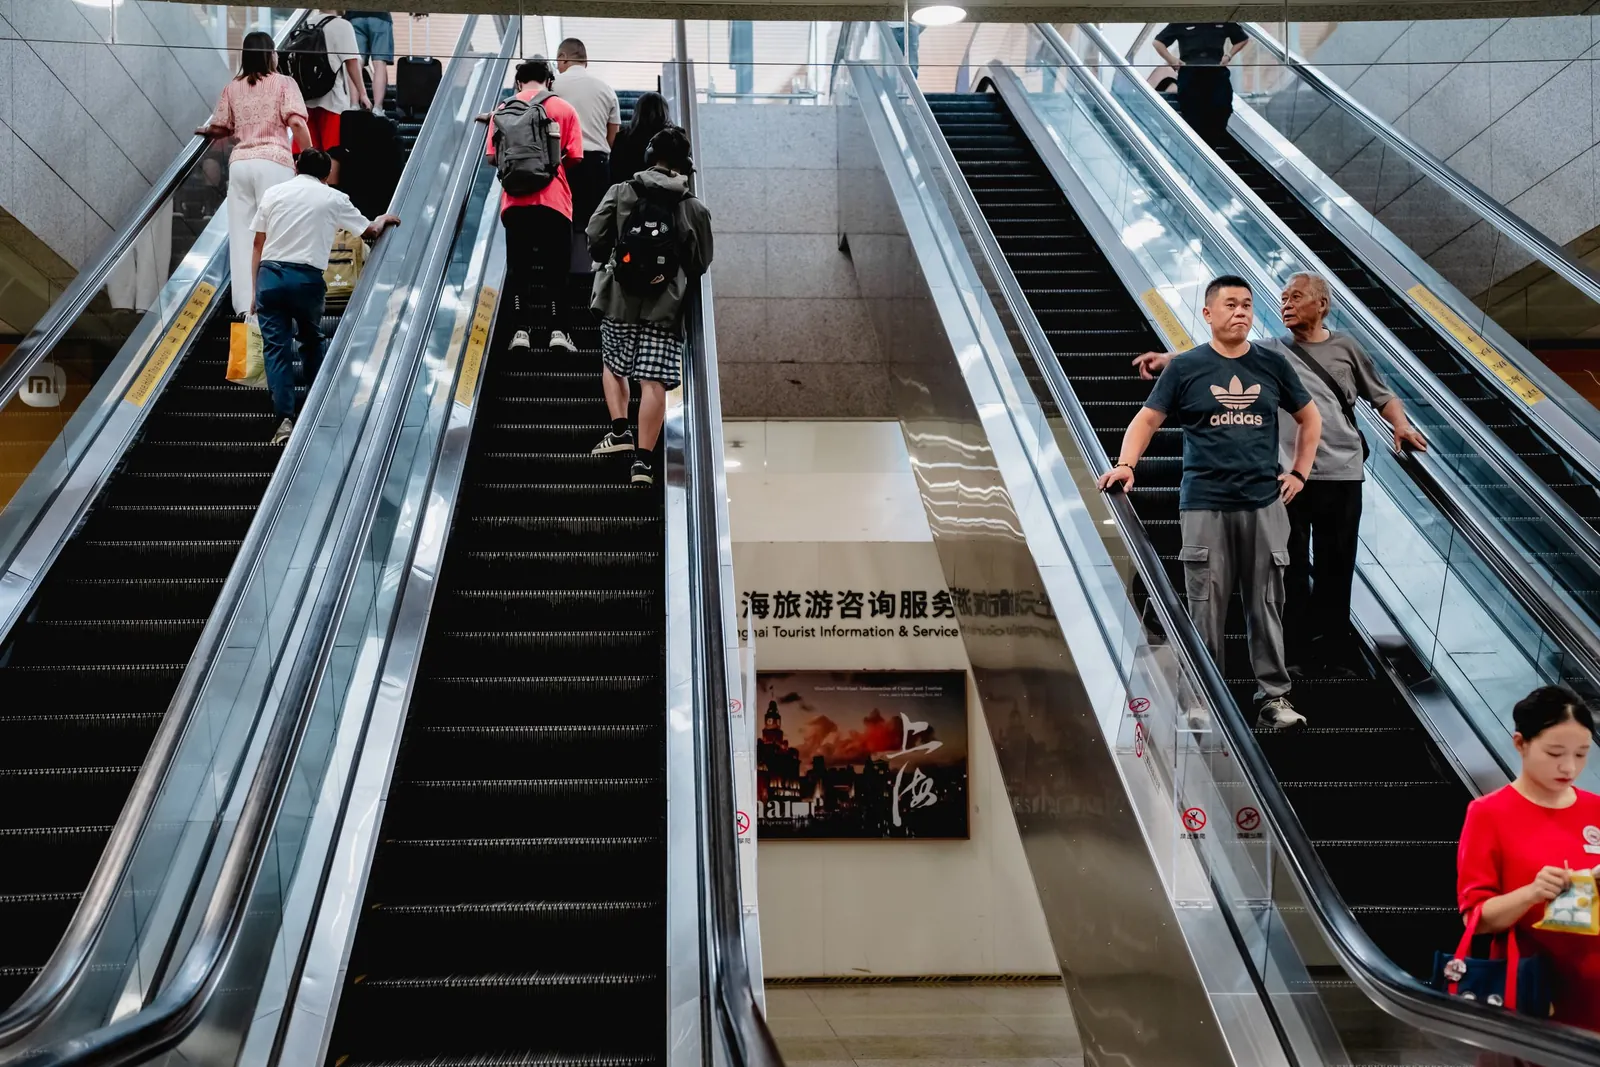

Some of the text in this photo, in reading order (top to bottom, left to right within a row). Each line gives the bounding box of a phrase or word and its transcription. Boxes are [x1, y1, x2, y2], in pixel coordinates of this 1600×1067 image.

[1210, 411, 1263, 426] adidas
[738, 590, 955, 619] 海旅游咨询服务
[772, 626, 816, 638] Tourist
[820, 625, 895, 637] Information
[899, 625, 908, 637] &
[913, 625, 959, 637] Service
